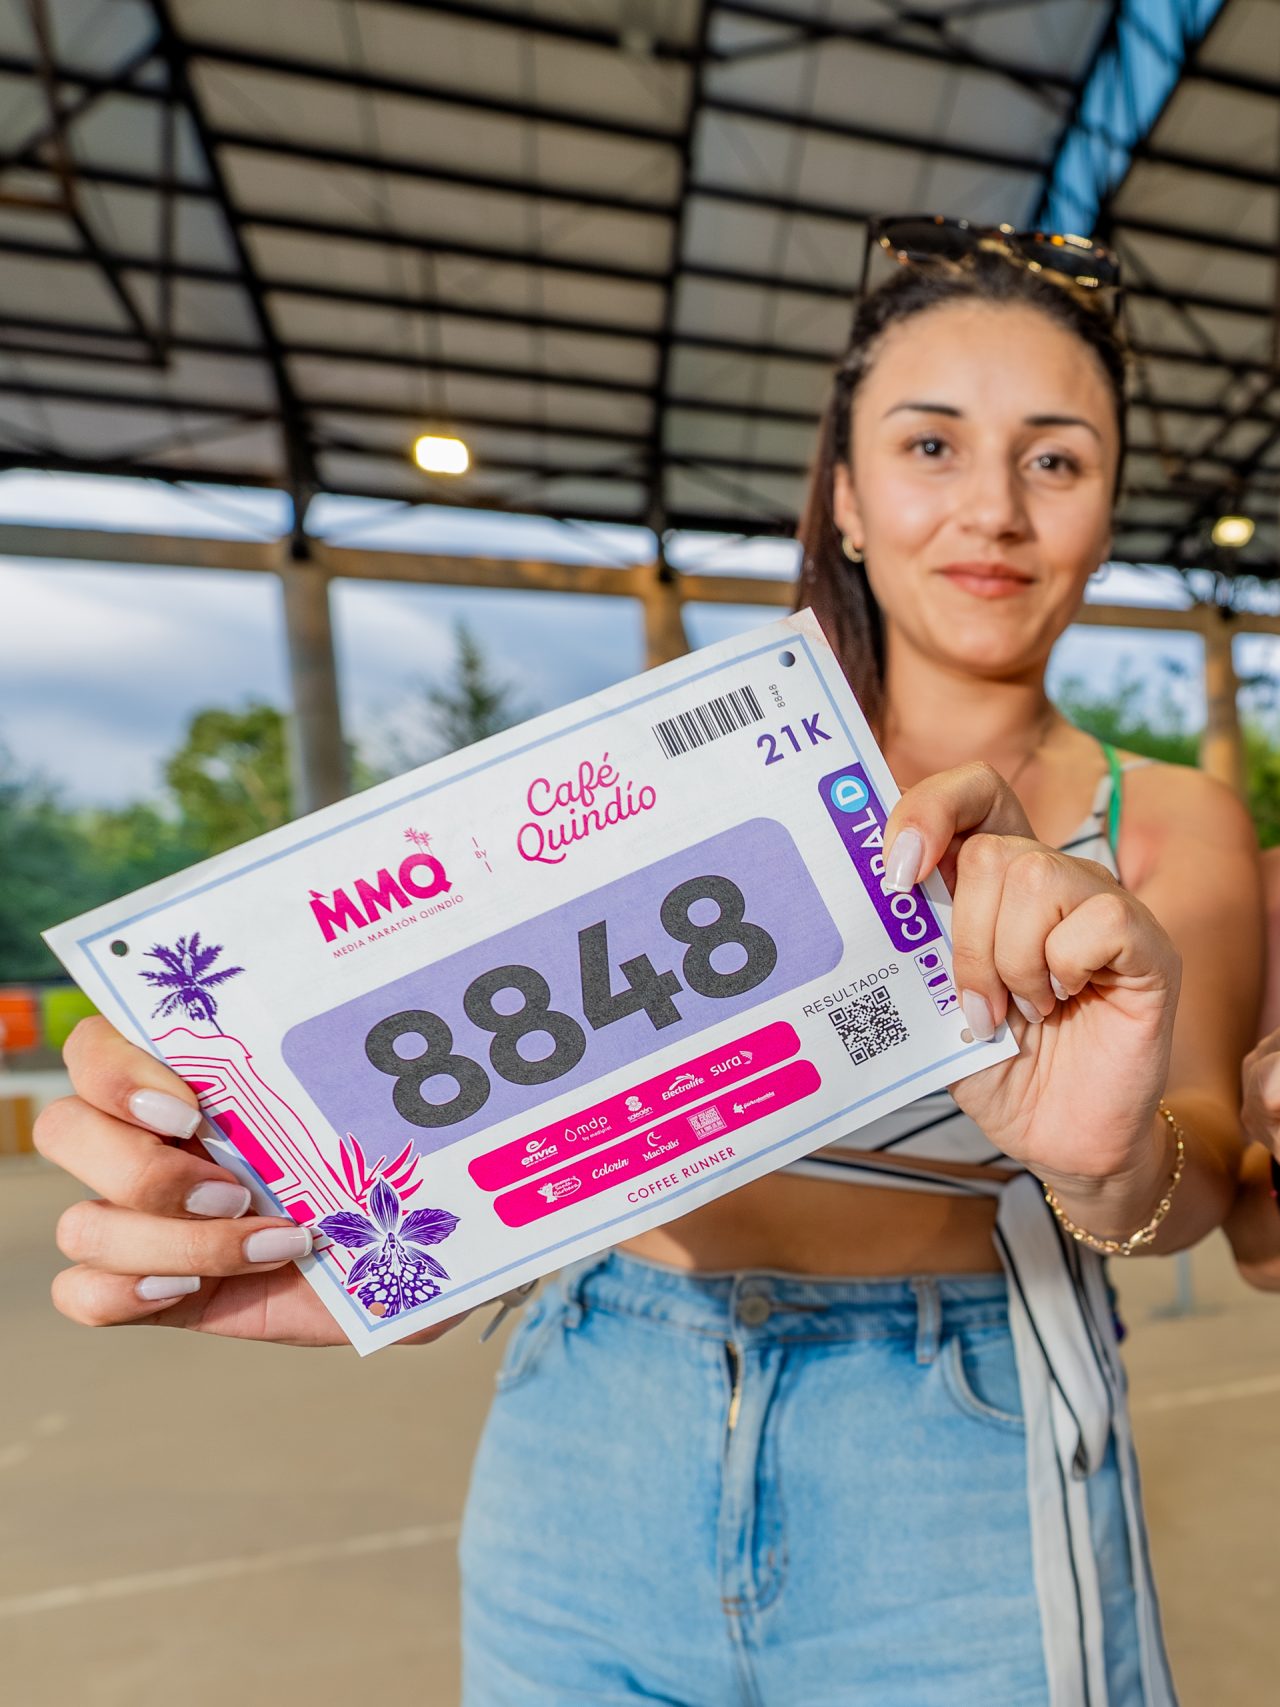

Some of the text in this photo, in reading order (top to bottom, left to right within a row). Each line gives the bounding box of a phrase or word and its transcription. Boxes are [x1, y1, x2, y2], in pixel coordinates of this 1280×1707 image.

[768, 683, 786, 708] 8848
[757, 712, 832, 766] 21K
[527, 752, 620, 816] Café
[836, 779, 865, 807] D
[517, 781, 656, 864] Quindío
[474, 849, 487, 859] By
[309, 853, 453, 943] MMQ
[333, 939, 366, 959] MEDIA
[365, 875, 777, 1128] 8848
[802, 963, 899, 1018] RESULTADOS
[710, 1055, 742, 1077] sura
[661, 1077, 705, 1101] Electrolife
[576, 1116, 608, 1136] mdp
[642, 1139, 680, 1162] MacPollo
[591, 1158, 629, 1179] Colorin
[627, 1146, 736, 1203] COFFEE RUNNER
